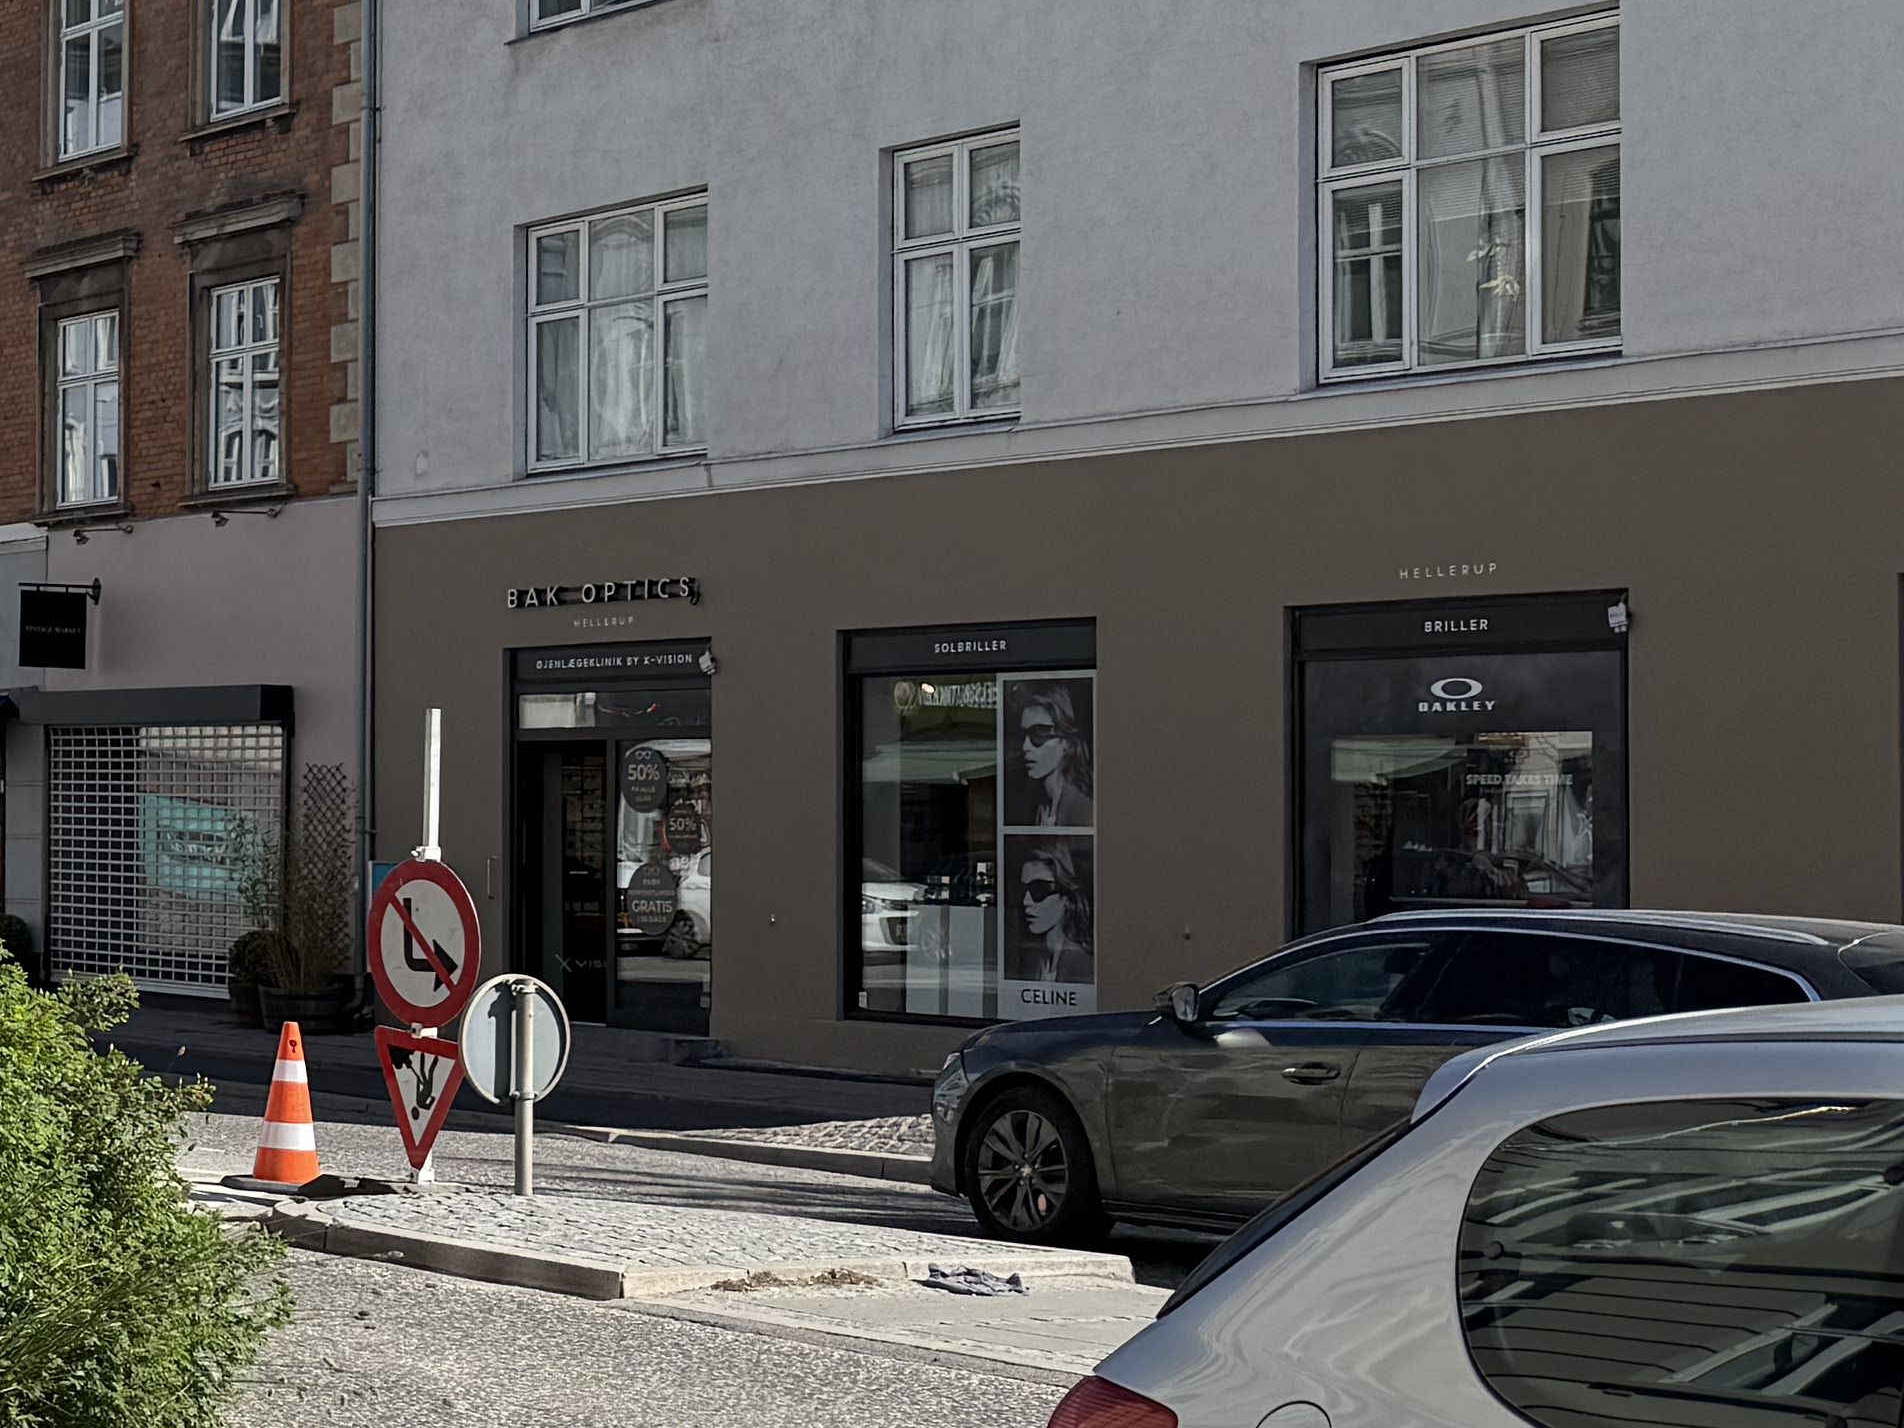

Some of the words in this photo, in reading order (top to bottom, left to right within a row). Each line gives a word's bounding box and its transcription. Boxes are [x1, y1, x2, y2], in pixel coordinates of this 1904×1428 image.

[1399, 563, 1497, 579] HELLERUP
[507, 585, 559, 609] BAK
[581, 576, 690, 603] OPTICS
[573, 616, 634, 628] HELLERUP
[1424, 619, 1488, 632] BRILLER
[934, 640, 1007, 653] SOLBRILLER
[536, 656, 622, 670] ØJENLÆGEKLINIK
[627, 655, 638, 667] BY
[643, 654, 693, 666] X-VISION
[1418, 701, 1496, 712] OAKLEY
[627, 764, 660, 781] 50%
[1466, 774, 1502, 785] SPEED
[669, 817, 697, 831] 50%
[631, 900, 673, 913] GRATIS
[1021, 988, 1078, 1006] CELINE
